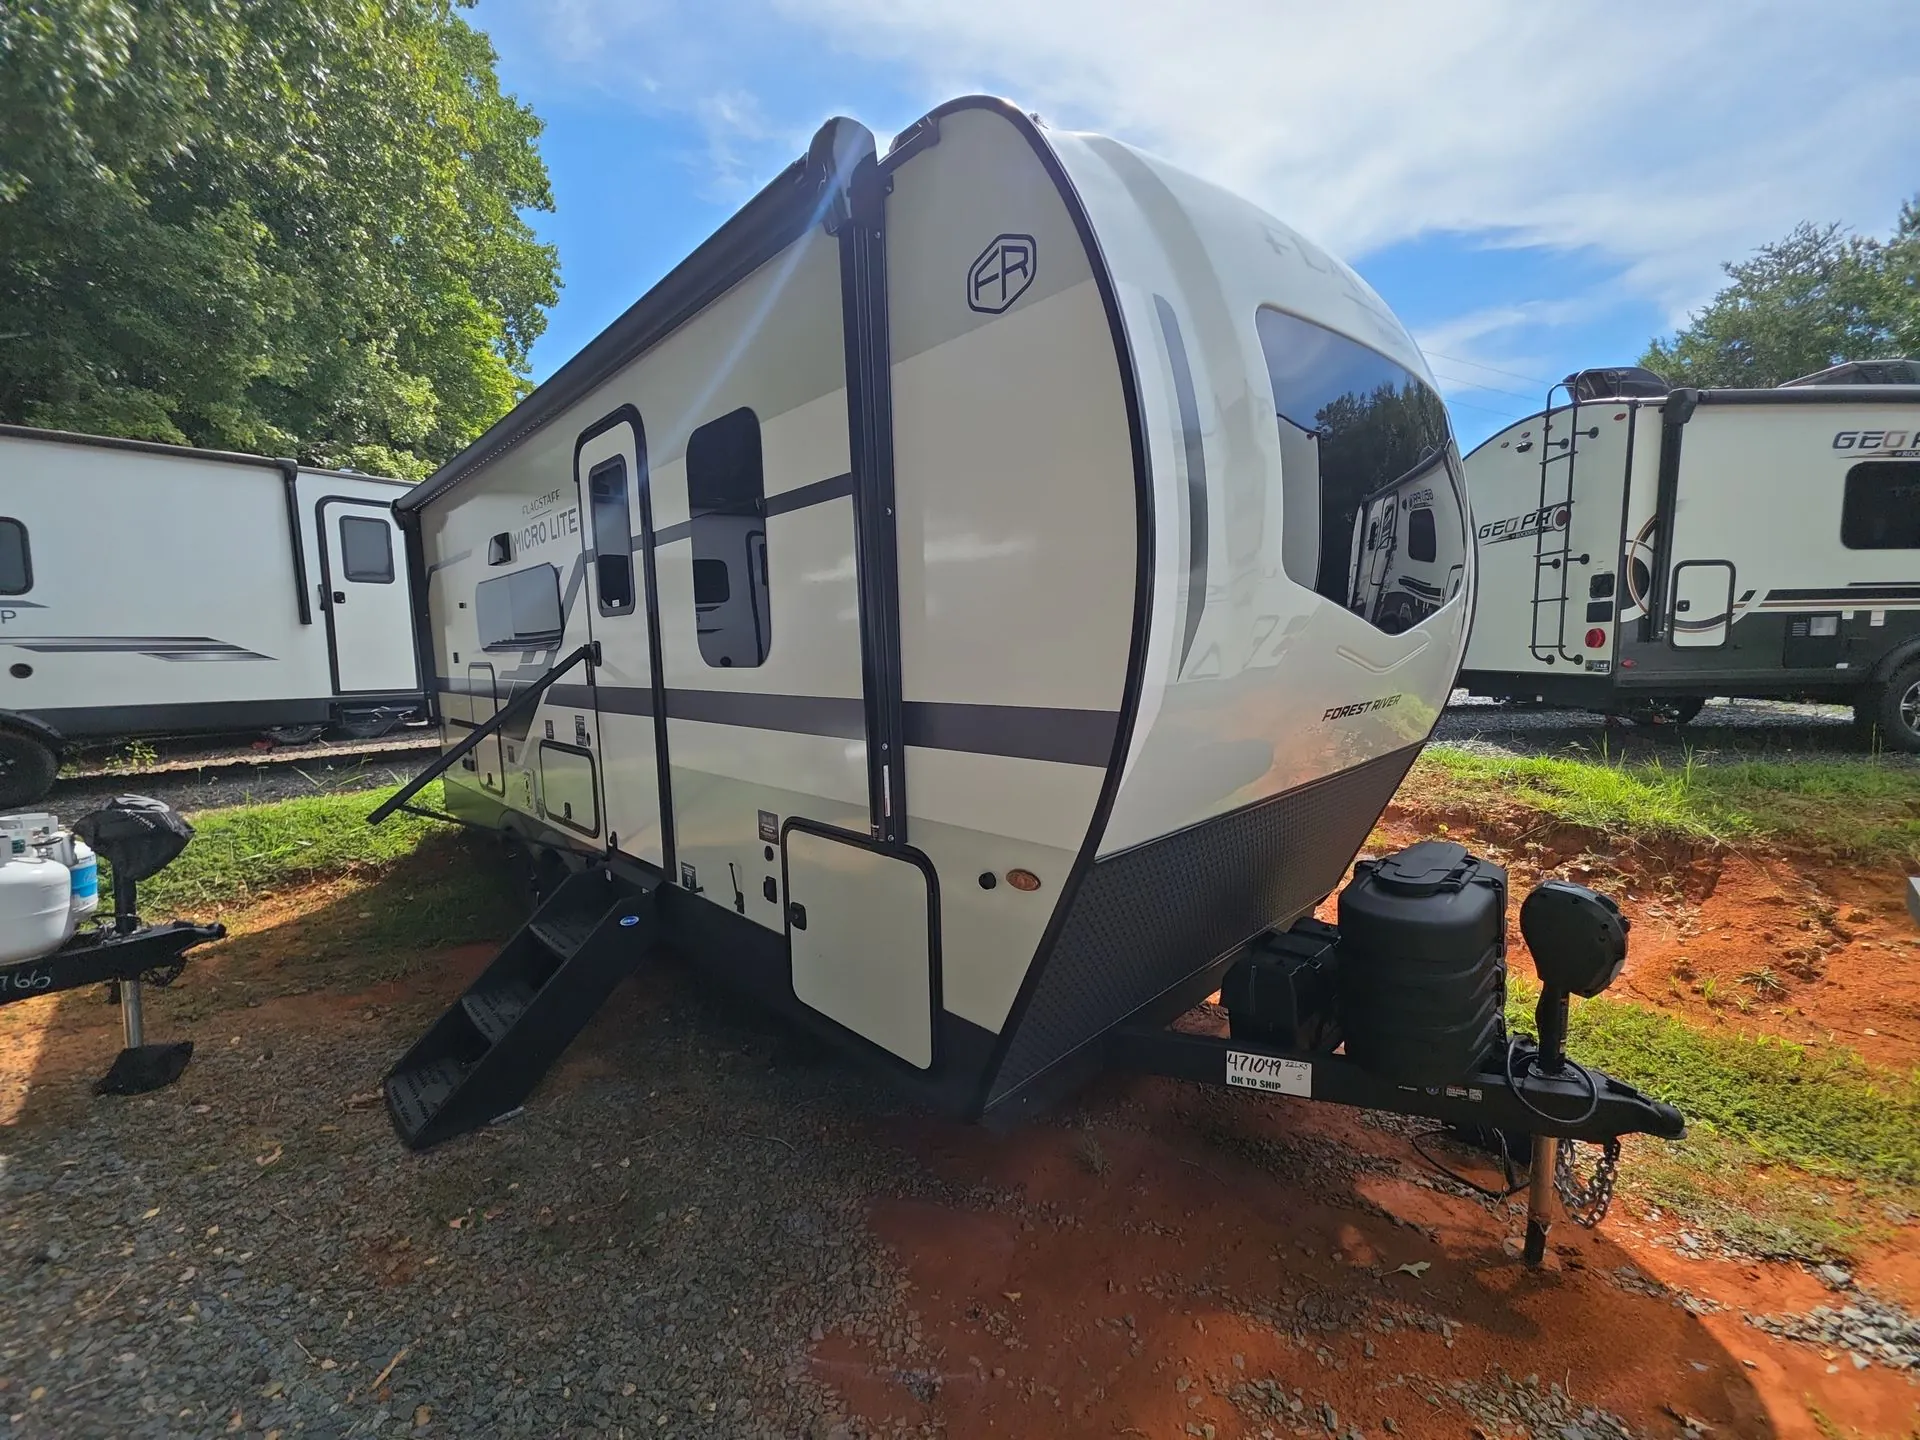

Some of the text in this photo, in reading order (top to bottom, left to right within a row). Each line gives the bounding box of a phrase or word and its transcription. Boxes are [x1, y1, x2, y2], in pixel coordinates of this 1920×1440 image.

[1832, 431, 1908, 449] GEO
[522, 489, 561, 515] FLAGSTAFF
[509, 508, 578, 553] MICRO LITE
[1478, 516, 1520, 539] GEO
[1521, 508, 1557, 530] PR
[1322, 694, 1402, 722] FOREST RIVER
[1227, 1053, 1281, 1077] 471049
[1231, 1075, 1281, 1091] OK TO SHIP
